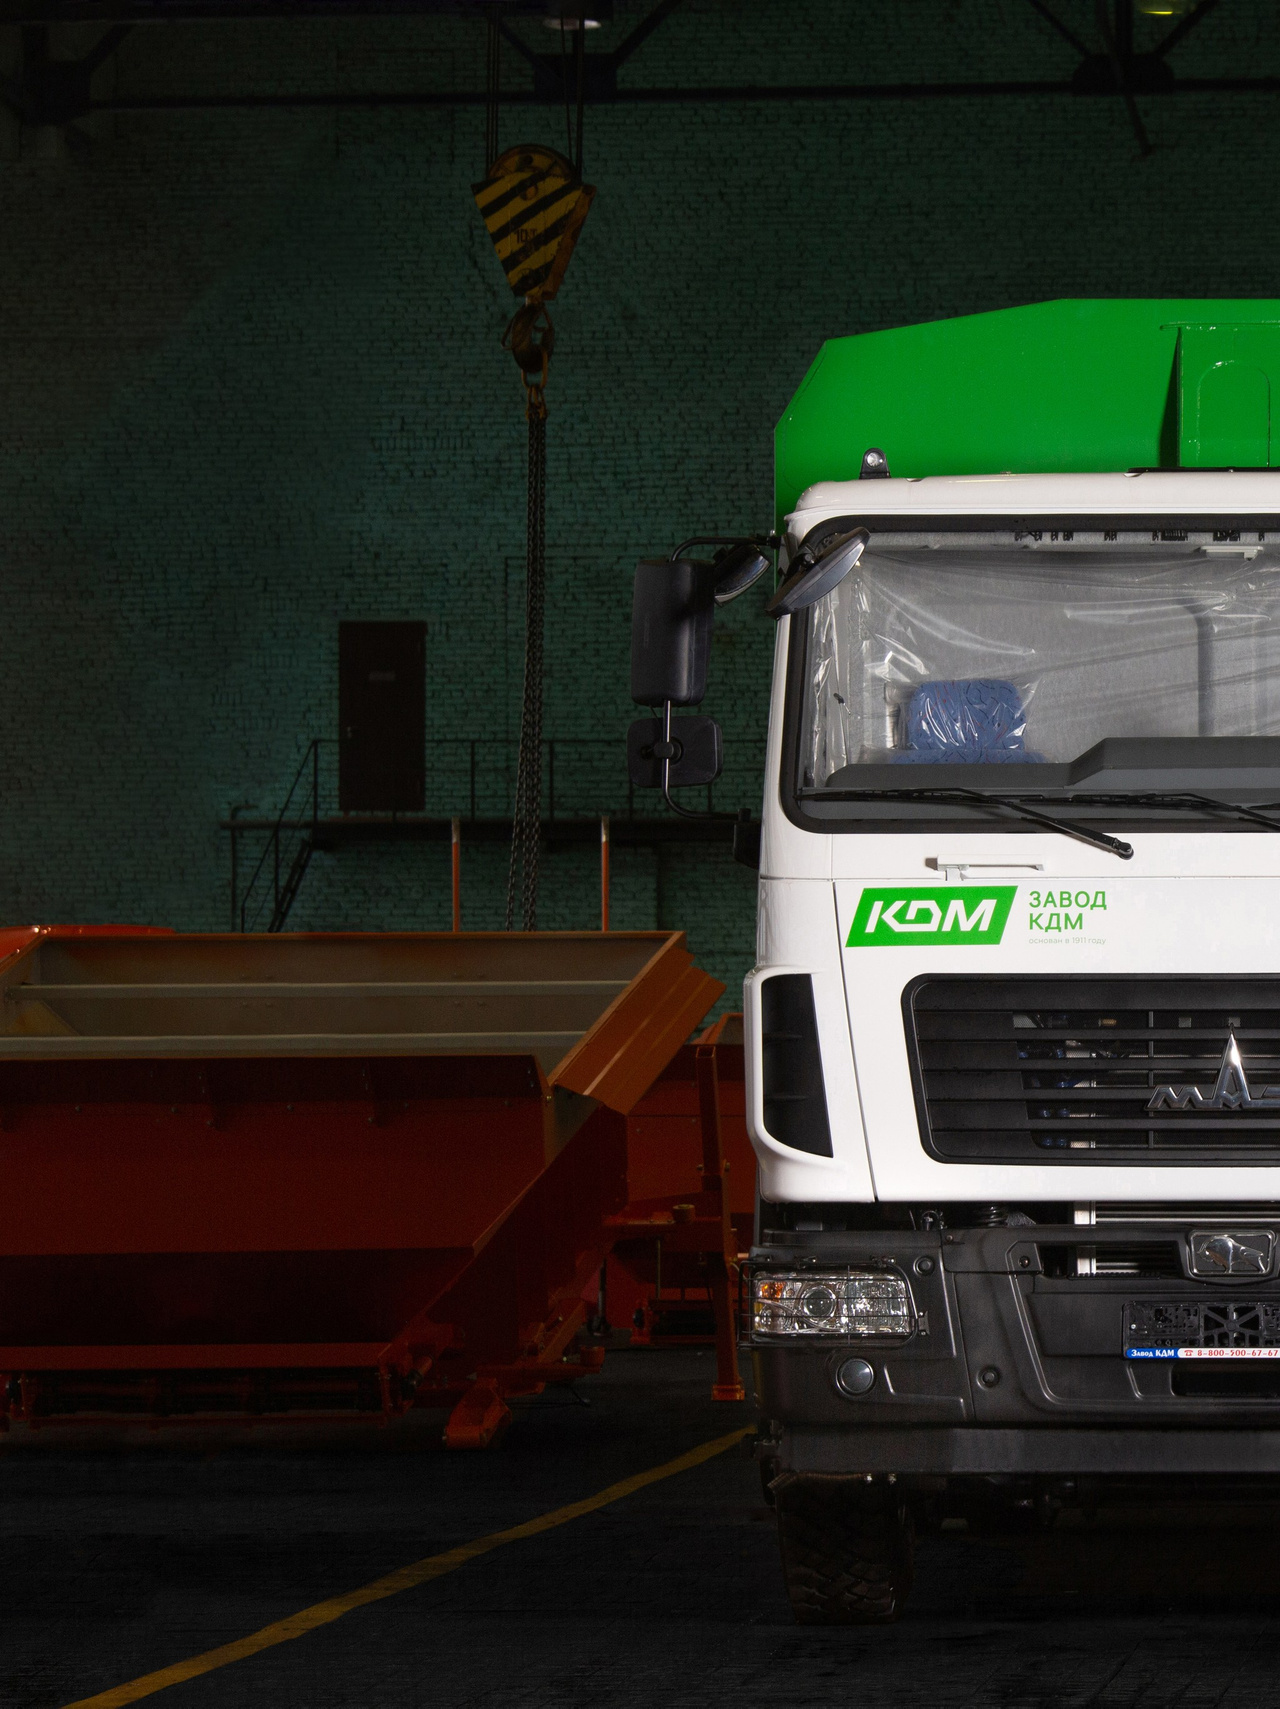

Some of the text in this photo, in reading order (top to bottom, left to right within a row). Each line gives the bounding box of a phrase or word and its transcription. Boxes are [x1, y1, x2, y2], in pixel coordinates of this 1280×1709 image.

[1028, 890, 1108, 911] ЗАВОД
[1029, 912, 1084, 933] КДМ
[1072, 936, 1087, 944] 1911
[1155, 1349, 1175, 1357] КДМ
[1197, 1349, 1279, 1357] 8-800-500-67-67
